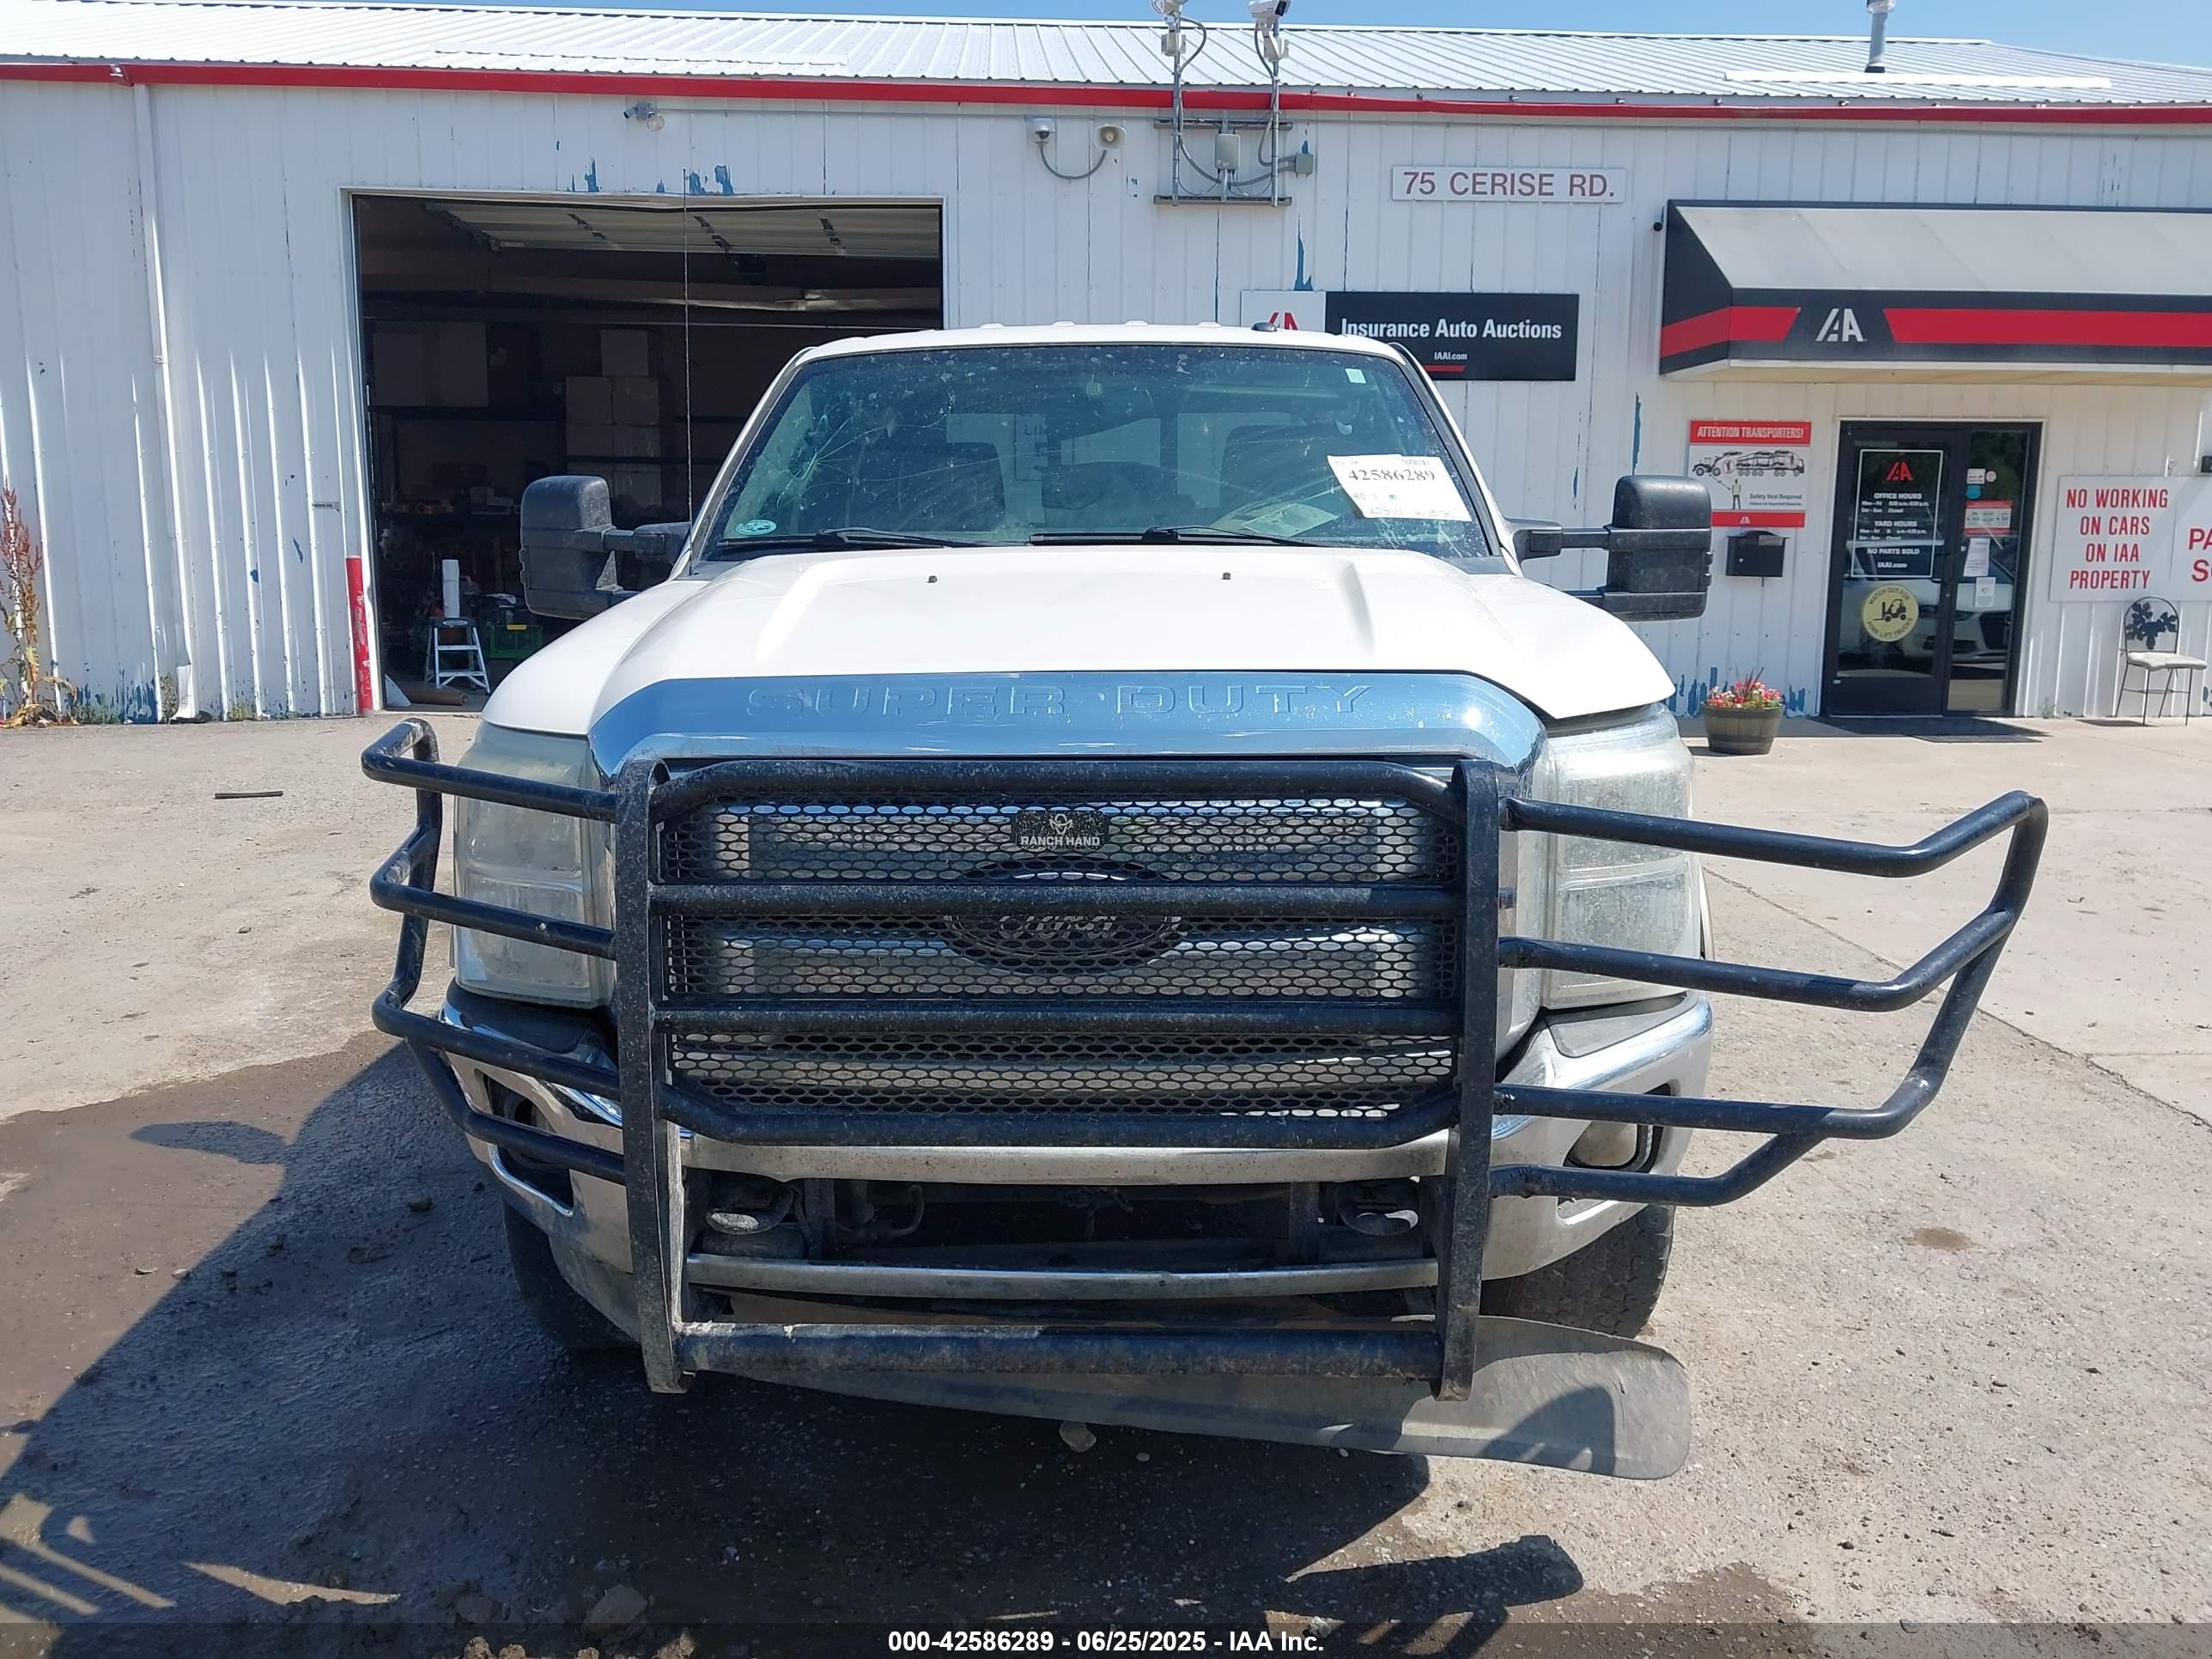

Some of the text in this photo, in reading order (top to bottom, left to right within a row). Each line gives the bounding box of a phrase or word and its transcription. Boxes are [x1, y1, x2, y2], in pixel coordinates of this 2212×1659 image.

[1404, 172, 1613, 198] 75 CERISE RD.
[1341, 318, 1562, 339] Insurance Auto Auctions
[1434, 352, 1468, 361] IAAI.com
[1697, 426, 1804, 439] ATTENTION TRANSPORTERS!
[1349, 470, 1436, 481] 42586289
[2066, 489, 2169, 508] NO WORKING
[2080, 516, 2150, 536] ON CARS
[2086, 544, 2139, 562] ON IAA
[2069, 570, 2151, 590] PROPERTY
[2191, 559, 2212, 582] S
[745, 686, 1371, 716] SUPER DUTY
[1020, 836, 1101, 847] RANCH HAND
